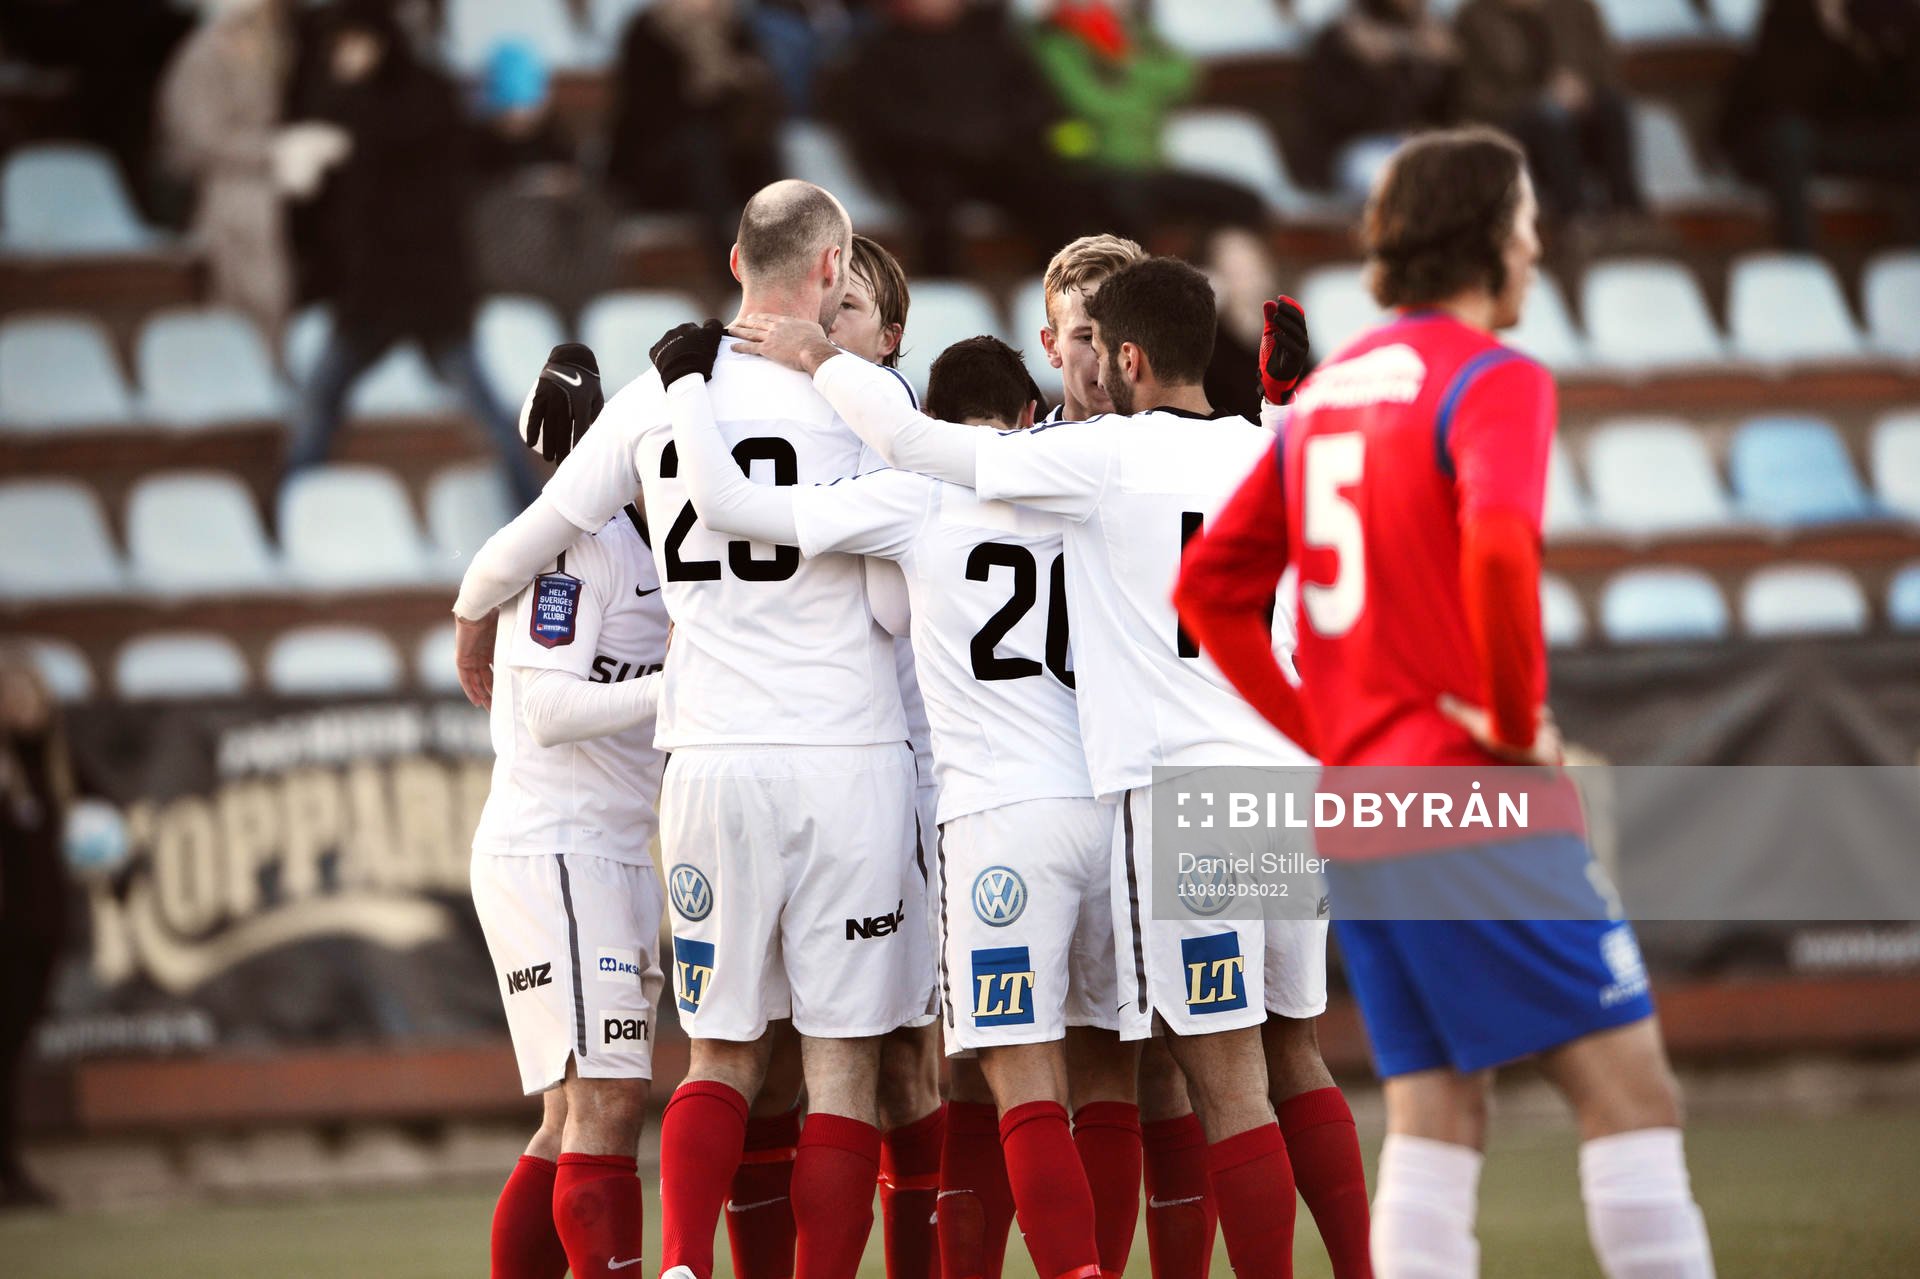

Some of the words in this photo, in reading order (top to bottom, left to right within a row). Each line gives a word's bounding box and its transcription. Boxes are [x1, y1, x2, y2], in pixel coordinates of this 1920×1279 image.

[1302, 430, 1366, 640] 5
[539, 595, 573, 607] SVERIGES
[548, 588, 567, 597] HELA
[538, 603, 573, 615] FOTBOLLS
[542, 612, 565, 621] KLUBB
[678, 961, 714, 1005] LT
[1185, 955, 1245, 1005] LT
[971, 971, 1035, 1017] LT
[604, 1018, 649, 1044] pan
